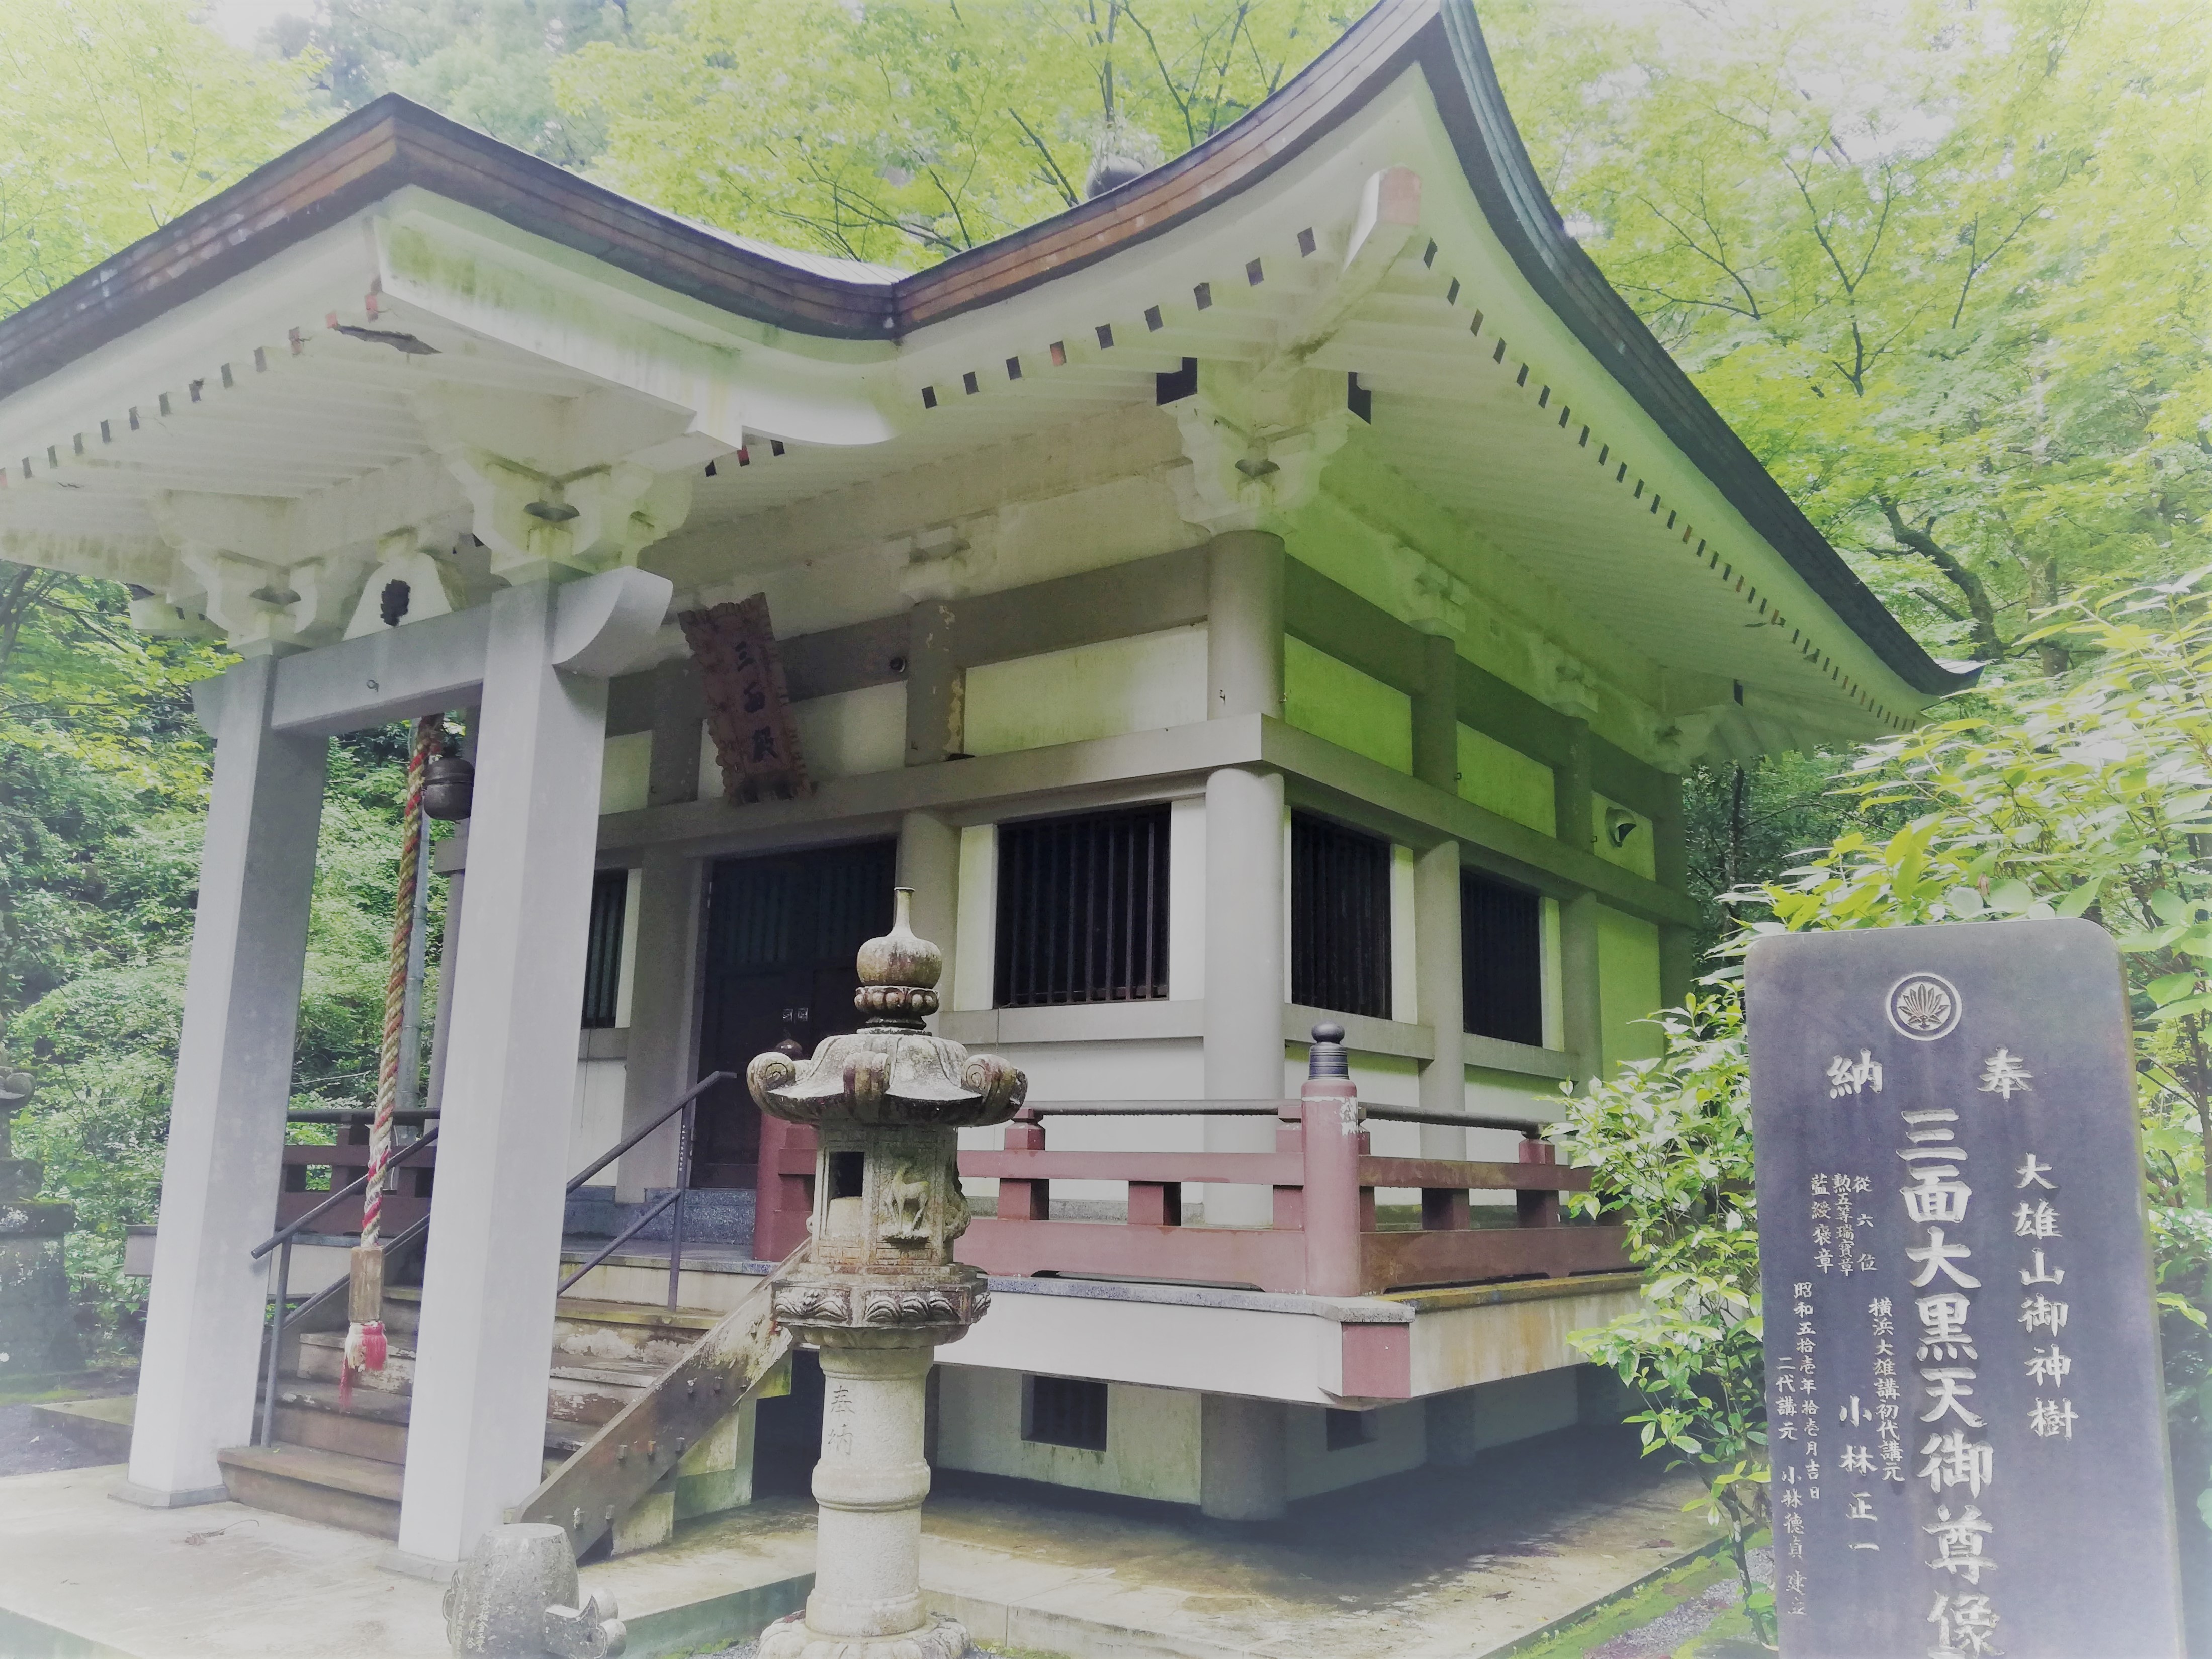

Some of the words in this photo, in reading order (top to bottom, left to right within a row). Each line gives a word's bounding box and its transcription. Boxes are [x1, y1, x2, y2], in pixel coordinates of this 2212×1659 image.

[1826, 1047, 1883, 1100] 納
[1977, 1047, 2033, 1102] 奉
[1811, 1172, 1834, 1274] 藍綬褒章
[2012, 1152, 2079, 1440] 大雄山御神樹
[828, 1385, 855, 1455] 奉納
[1775, 1357, 1798, 1441] 二代講元
[1868, 1296, 1905, 1482] 横浜大雄講初代講元
[1839, 1394, 1880, 1551] 小林正一
